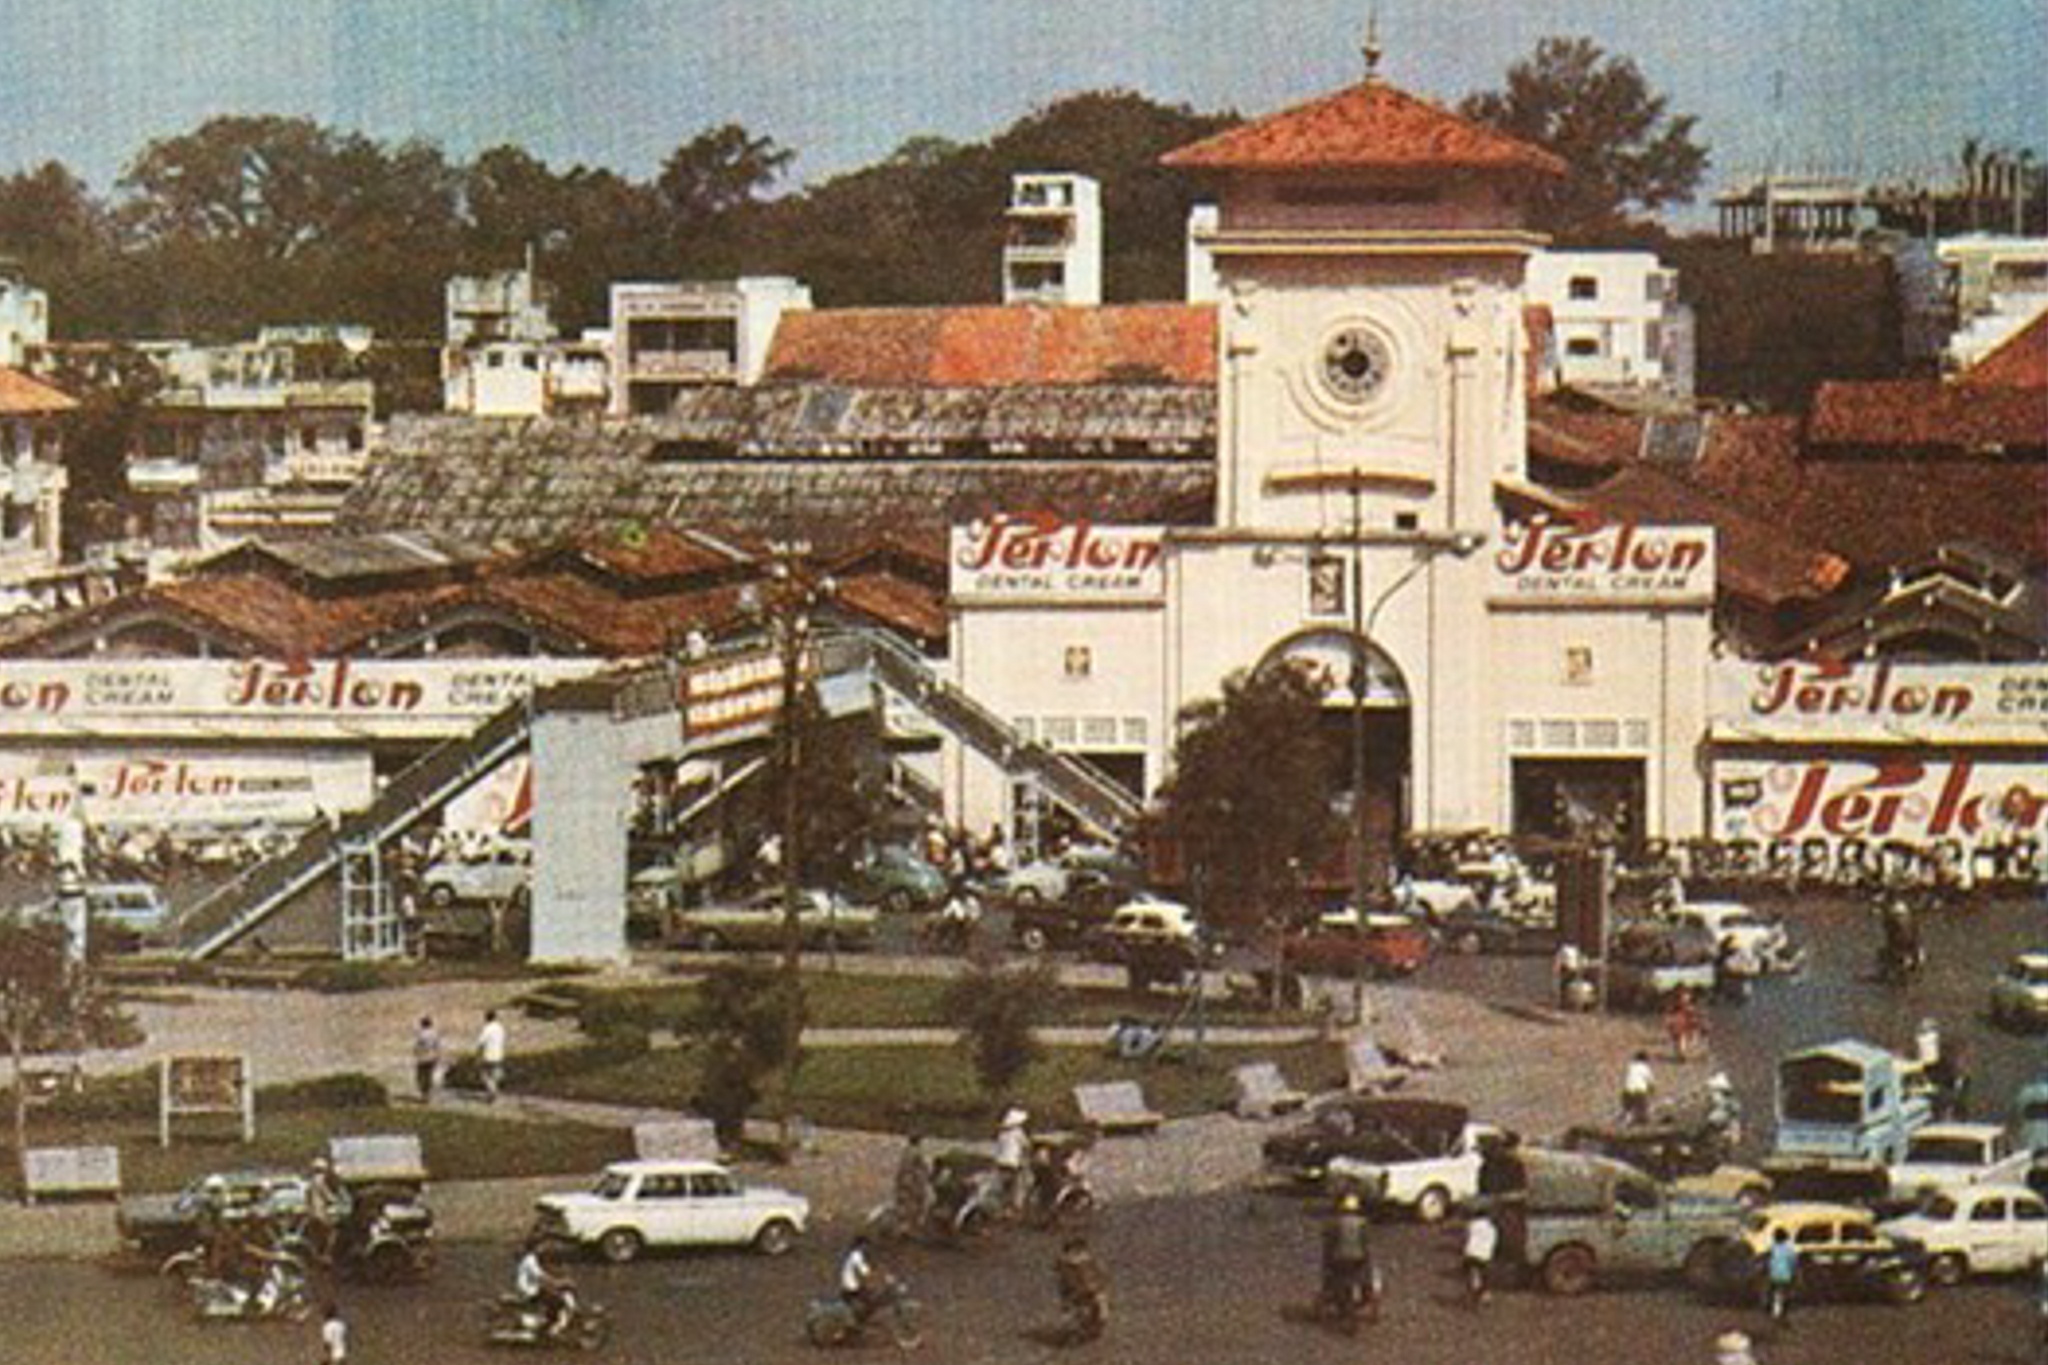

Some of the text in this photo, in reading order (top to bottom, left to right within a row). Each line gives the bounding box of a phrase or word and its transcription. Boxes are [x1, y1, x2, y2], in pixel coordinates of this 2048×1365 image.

[974, 573, 1141, 590] DENTAL CREAM
[1517, 576, 1688, 592] DENTAL CREAM
